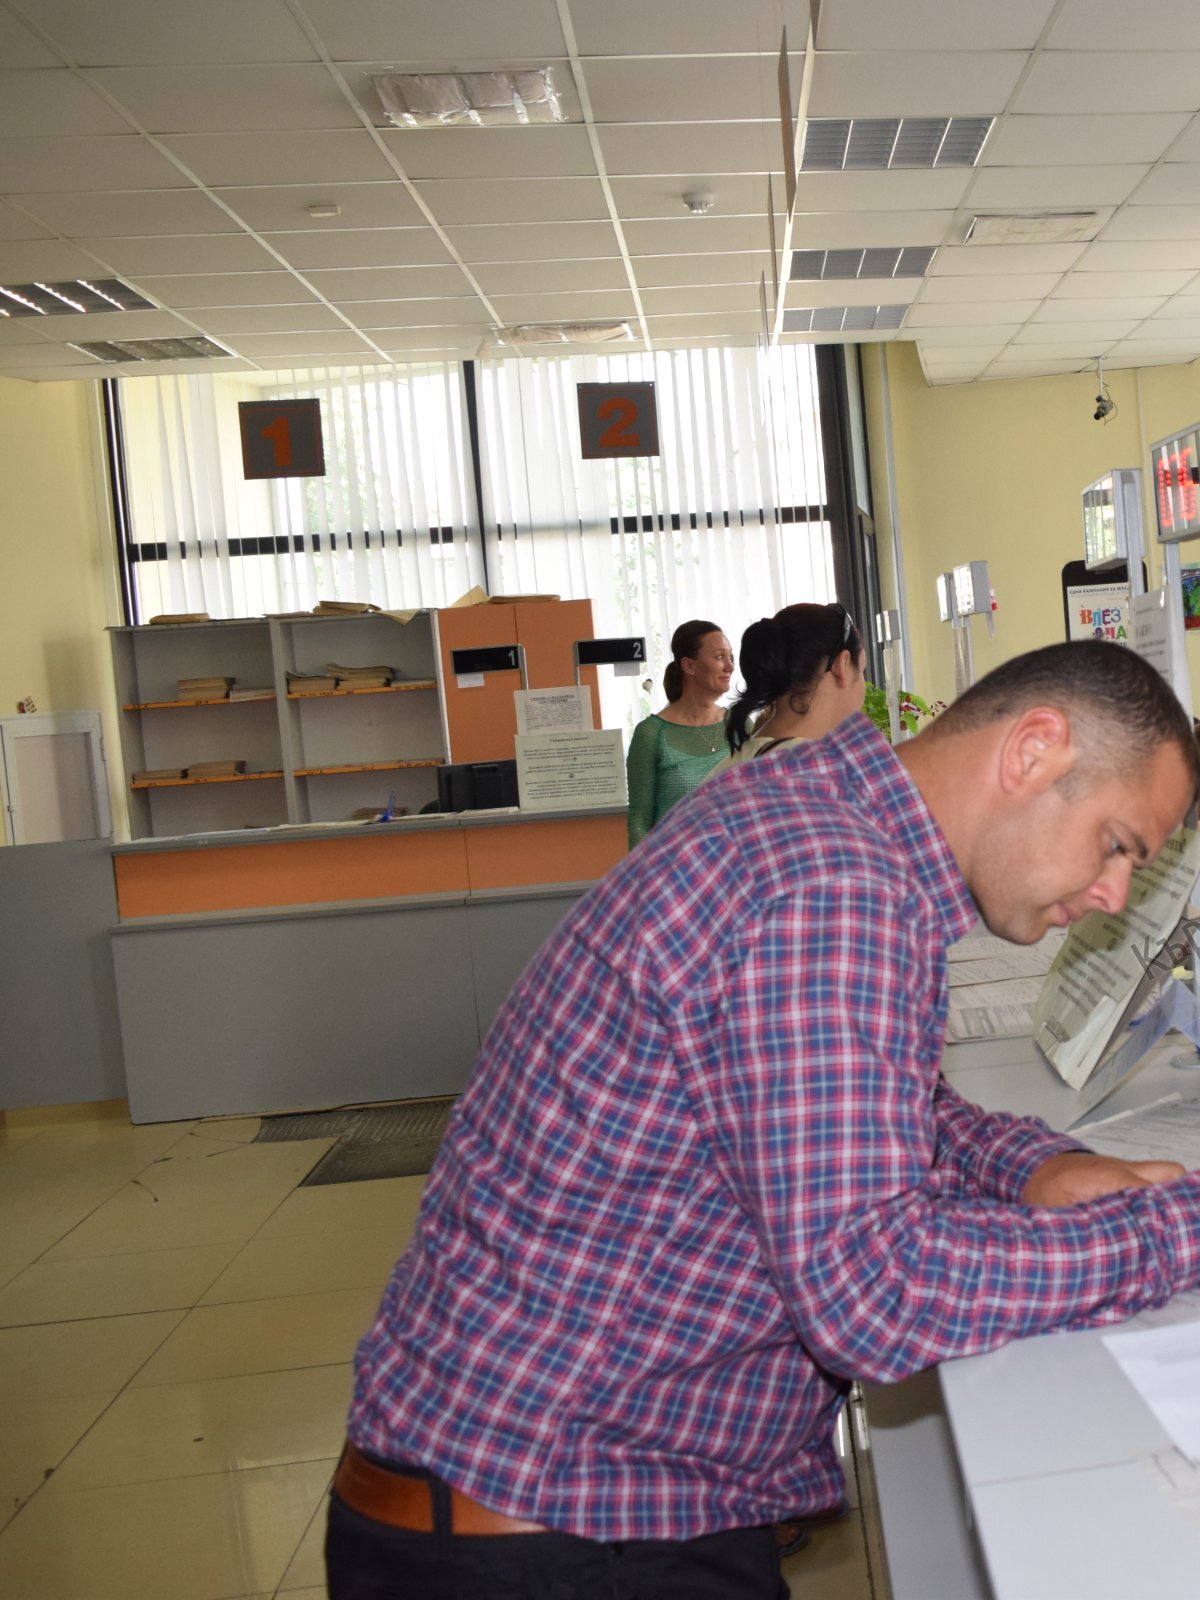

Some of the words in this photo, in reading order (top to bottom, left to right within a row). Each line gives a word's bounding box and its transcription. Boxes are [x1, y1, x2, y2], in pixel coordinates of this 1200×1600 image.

[597, 398, 640, 448] 2
[261, 416, 293, 467] 1
[508, 650, 516, 666] 1
[633, 642, 642, 659] 2
